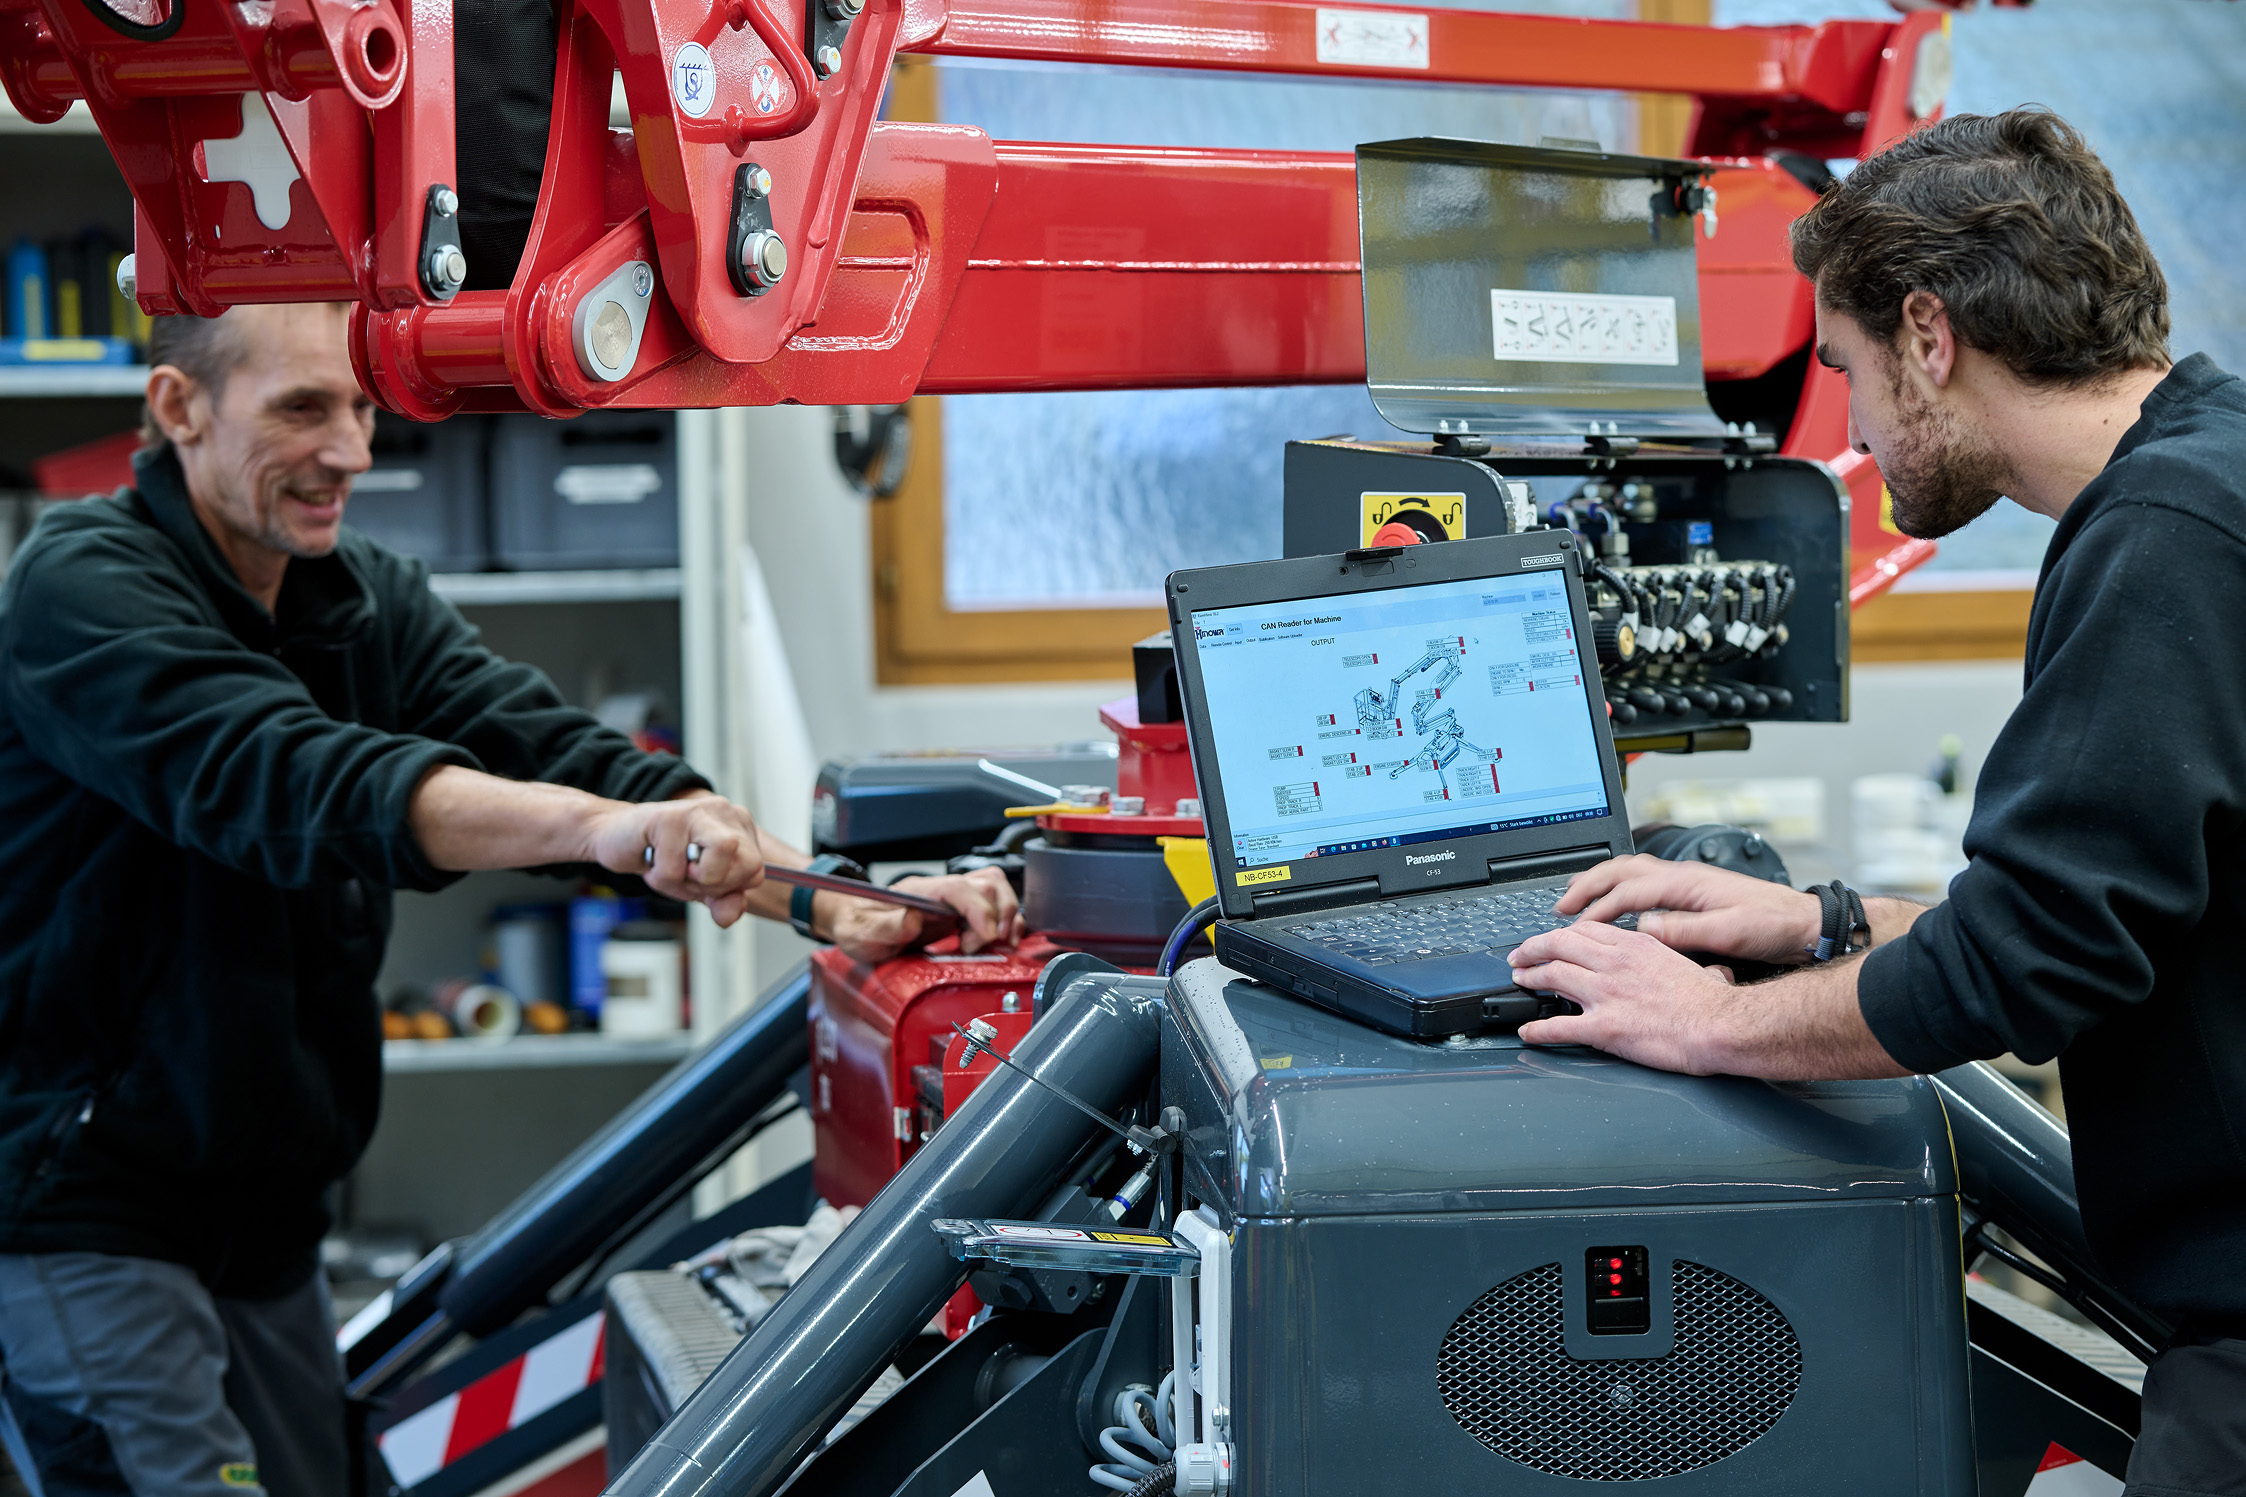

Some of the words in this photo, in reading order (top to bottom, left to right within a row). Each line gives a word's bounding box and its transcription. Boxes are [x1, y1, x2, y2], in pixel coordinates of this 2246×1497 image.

[1522, 555, 1562, 566] TOUGHBOOK
[1260, 622, 1277, 630] CAN
[1277, 619, 1302, 628] Reader
[1303, 617, 1313, 626] for
[1313, 614, 1342, 624] Machine
[1310, 638, 1336, 647] OUTPUT
[1406, 850, 1456, 866] Panasonic
[1244, 870, 1283, 882] NB-CF53-4
[1426, 868, 1441, 876] CF-53
